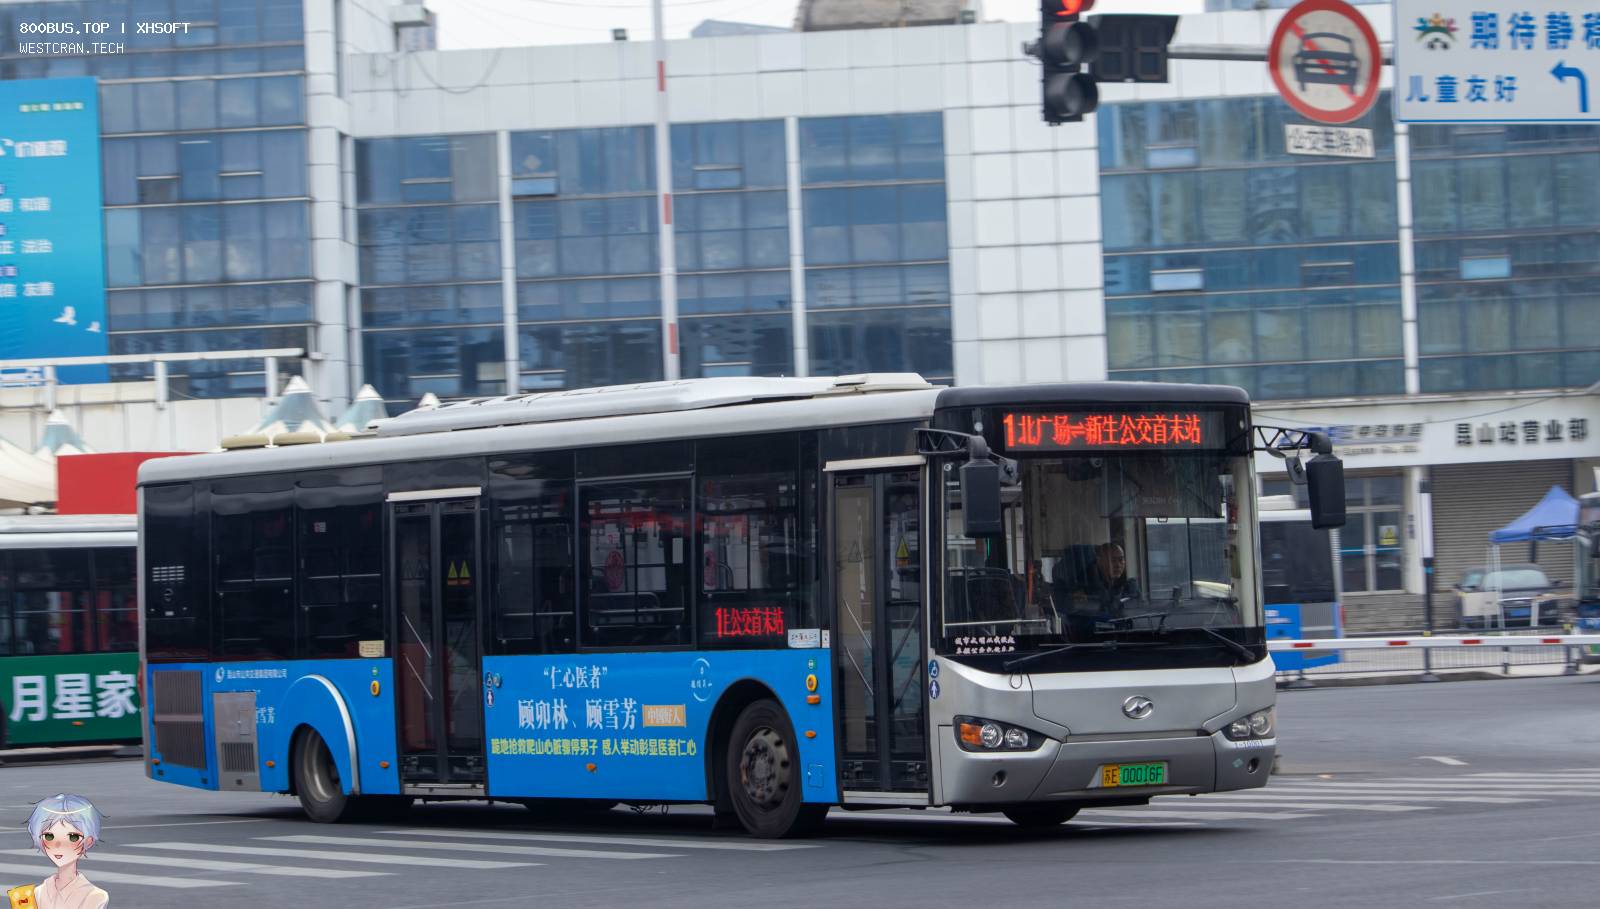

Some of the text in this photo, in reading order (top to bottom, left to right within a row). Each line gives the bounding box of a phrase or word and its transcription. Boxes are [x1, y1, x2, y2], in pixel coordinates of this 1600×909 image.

[1405, 75, 1518, 103] 儿童友好
[1456, 417, 1588, 445] 昆山站营业部
[9, 670, 142, 723] 月星家
